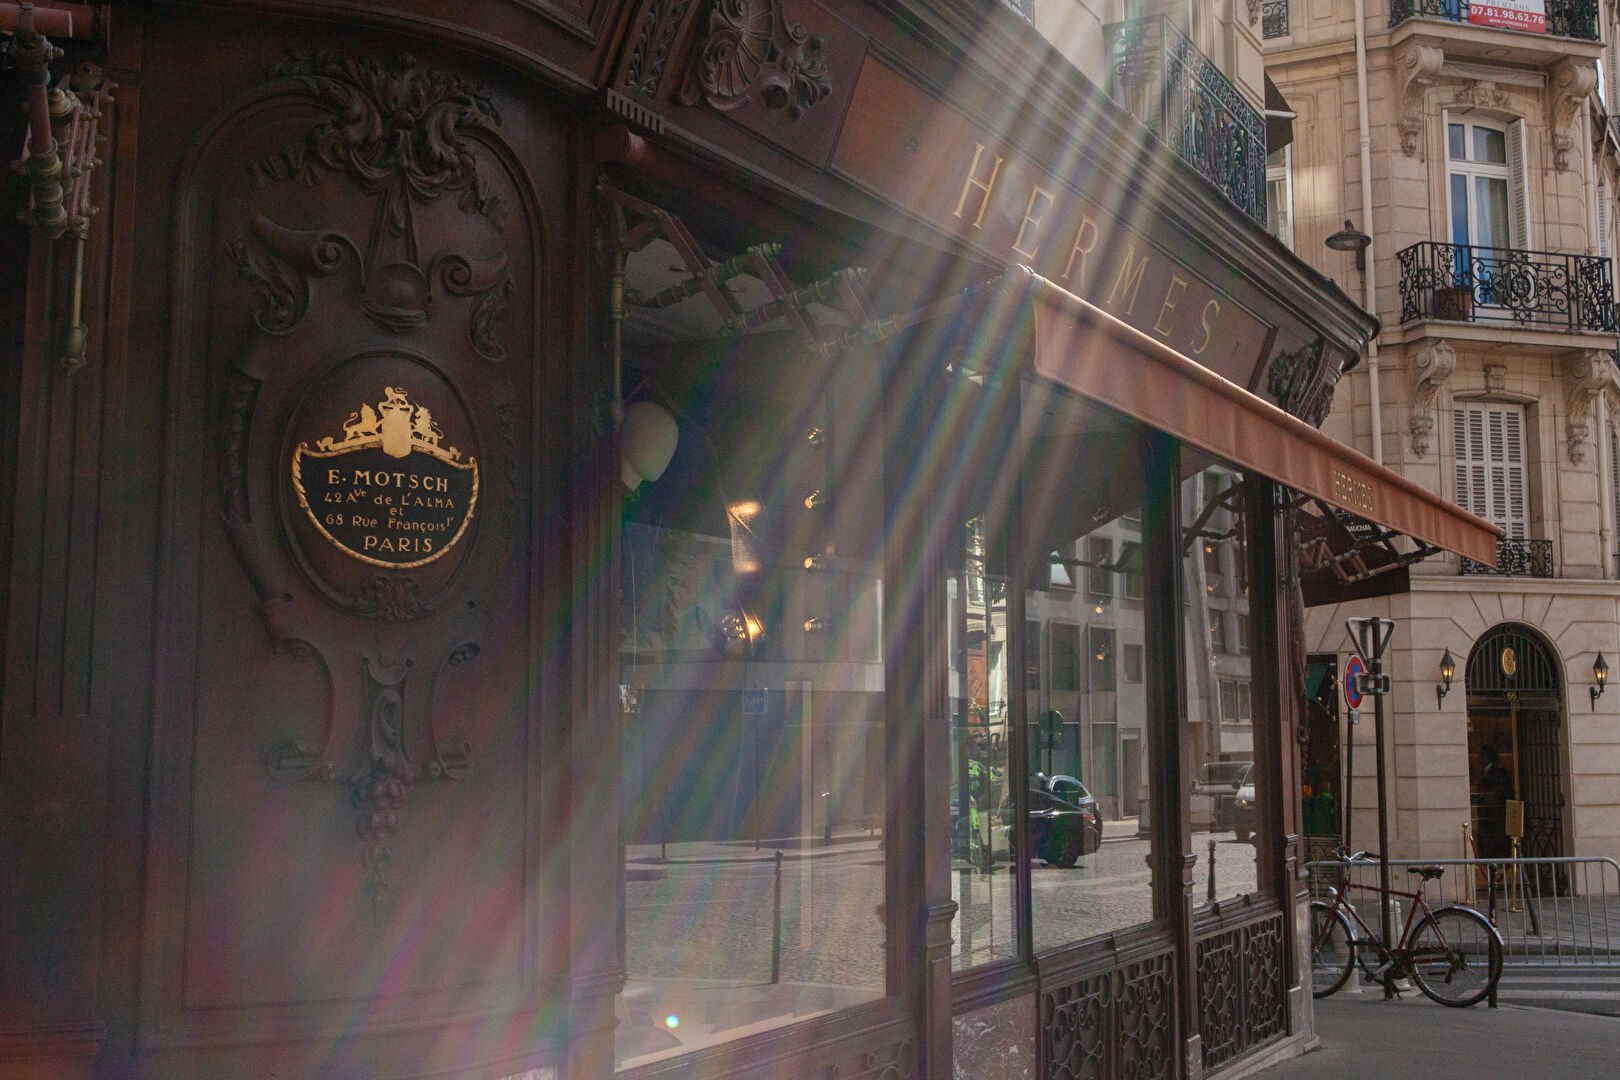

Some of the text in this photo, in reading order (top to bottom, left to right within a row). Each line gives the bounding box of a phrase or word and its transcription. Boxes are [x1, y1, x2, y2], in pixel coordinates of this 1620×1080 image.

[1471, 6, 1544, 24] 07.81.98.62.76
[952, 142, 1221, 355] HERMES
[353, 470, 449, 493] MOTSCH
[324, 492, 342, 503] 42
[374, 494, 392, 505] de
[401, 491, 454, 508] L'ALMA
[389, 507, 404, 516] et
[326, 513, 344, 526] 68
[352, 516, 378, 527] Rue
[387, 517, 446, 533] François
[363, 535, 433, 553] PARIS
